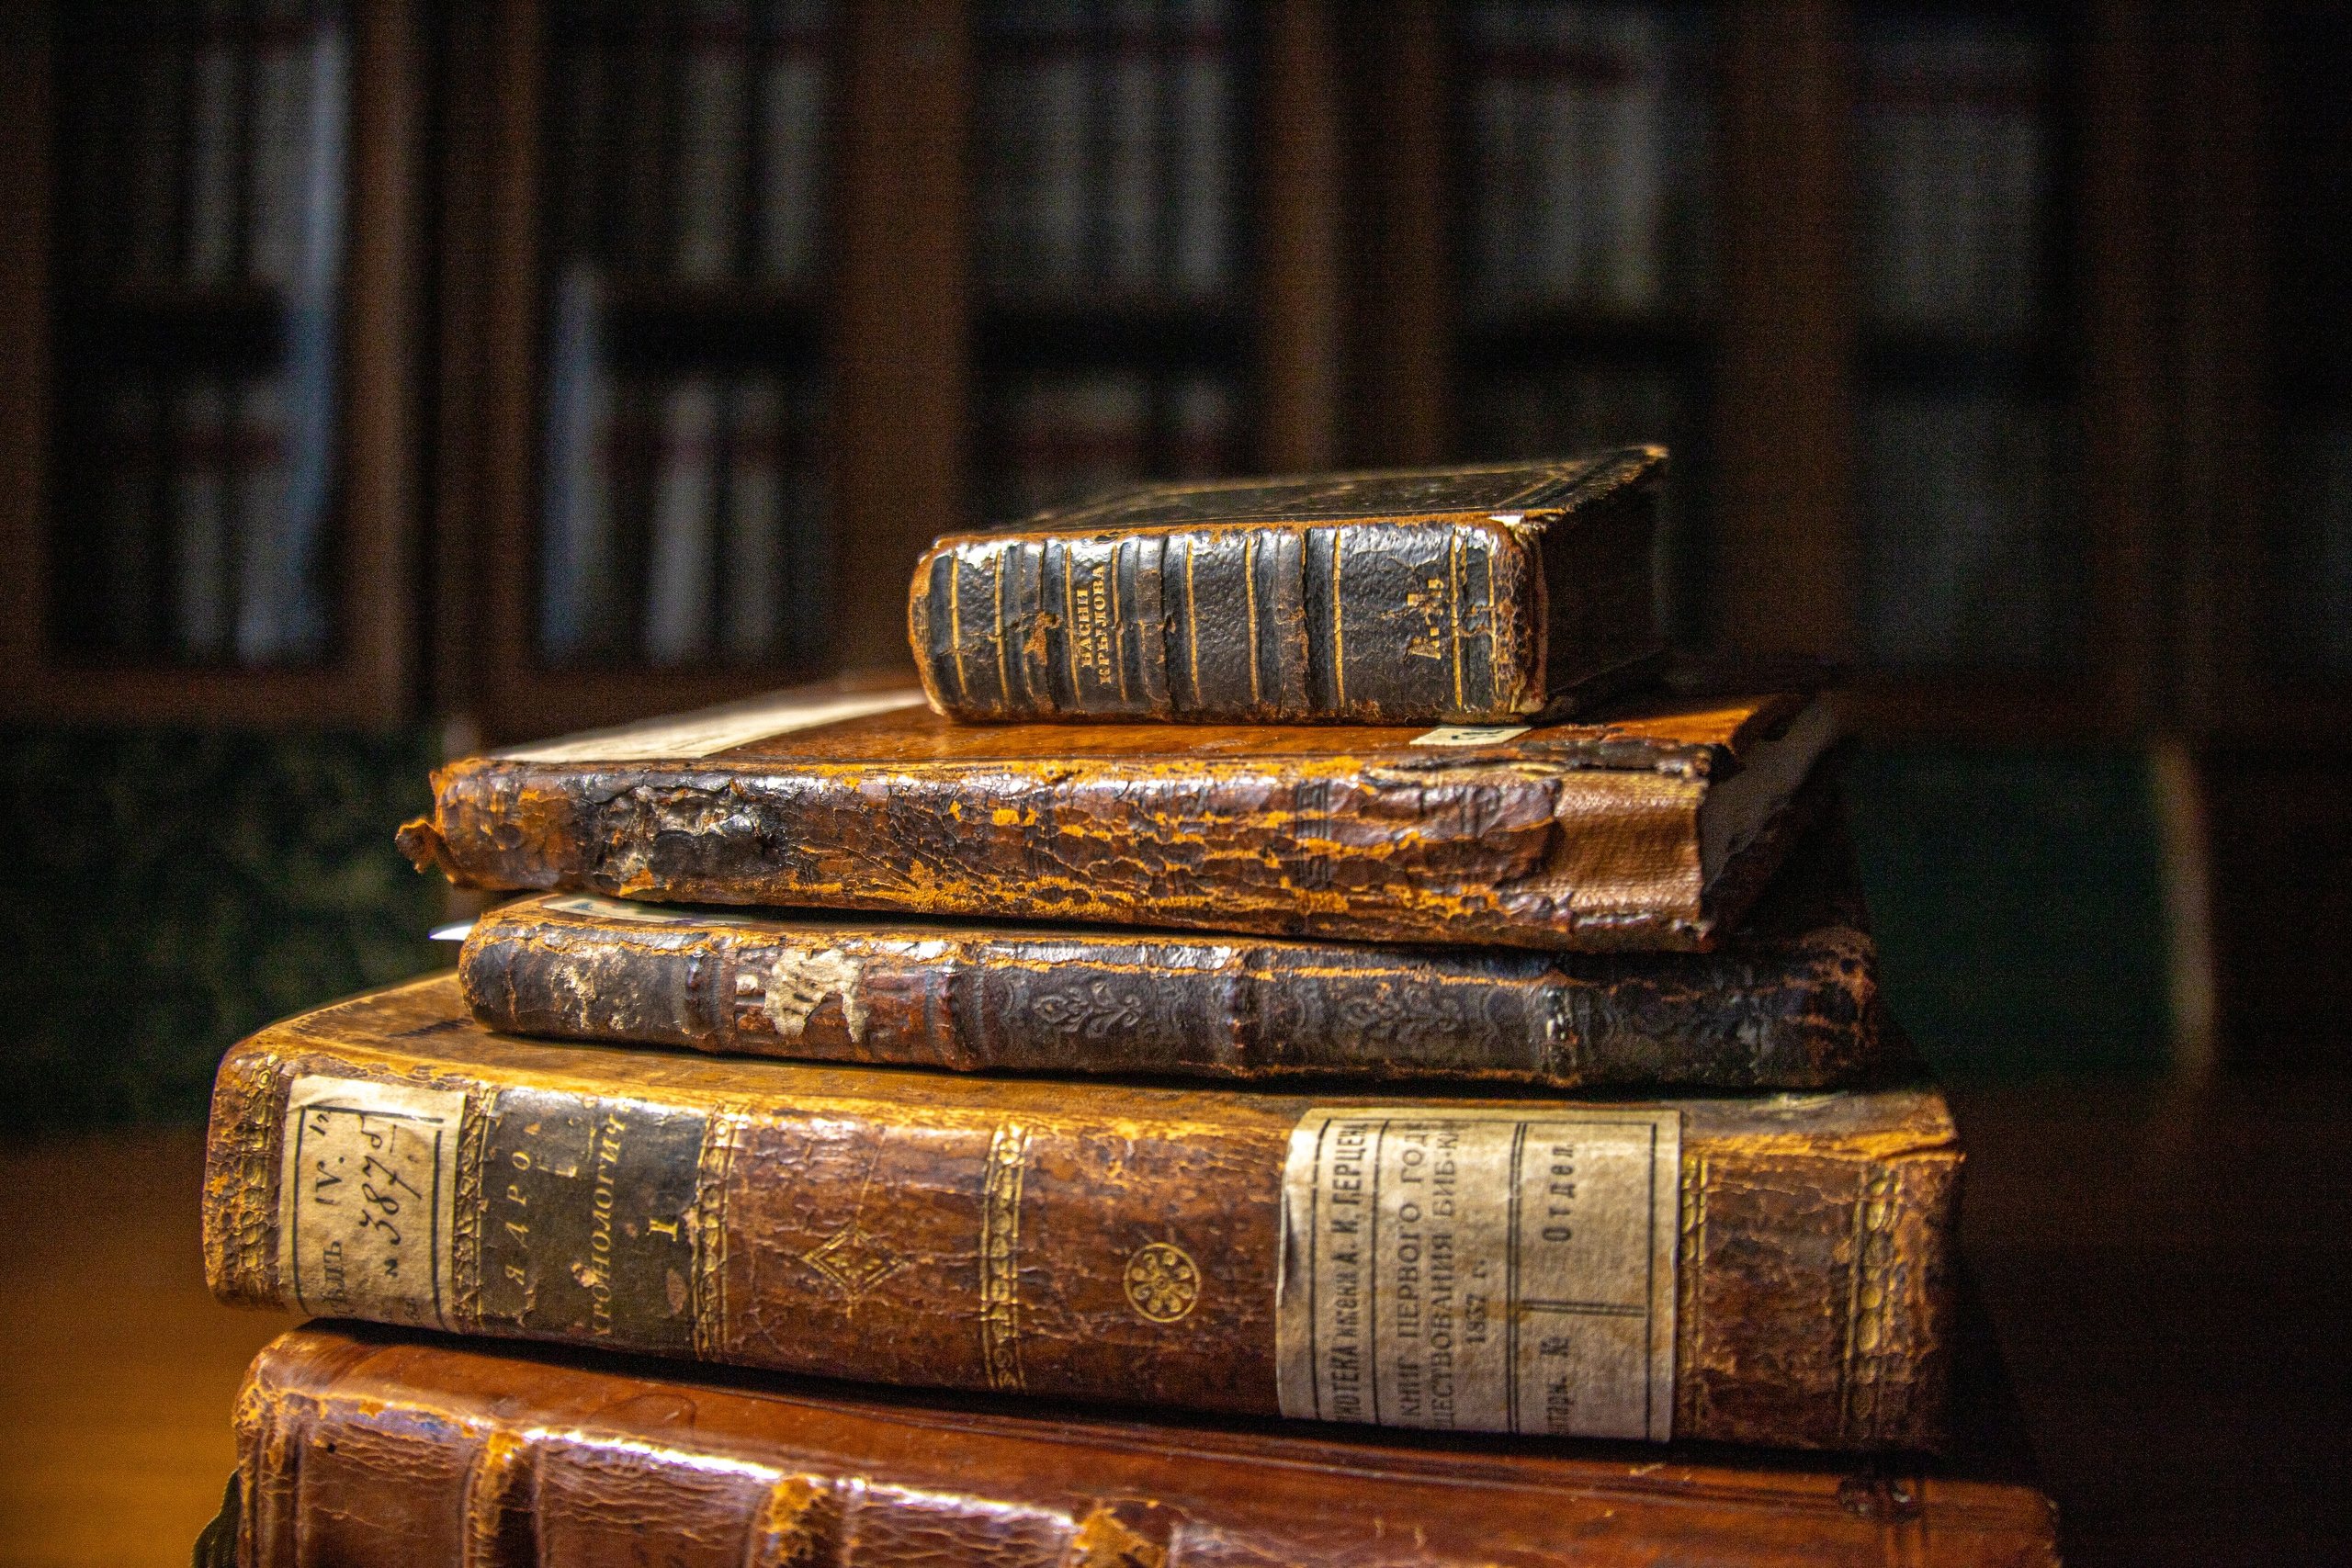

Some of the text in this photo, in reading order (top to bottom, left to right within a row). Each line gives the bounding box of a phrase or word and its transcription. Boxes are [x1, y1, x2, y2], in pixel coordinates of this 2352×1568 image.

[1092, 564, 1112, 685] КРЫЛОВА
[504, 1150, 531, 1286] ЯДРО
[1541, 1143, 1576, 1243] Отдел.
[1397, 1201, 1423, 1339] ПЕРВОГО
[1330, 1340, 1363, 1422] ИОТЕКА
[1396, 1358, 1423, 1419] КНИГ
